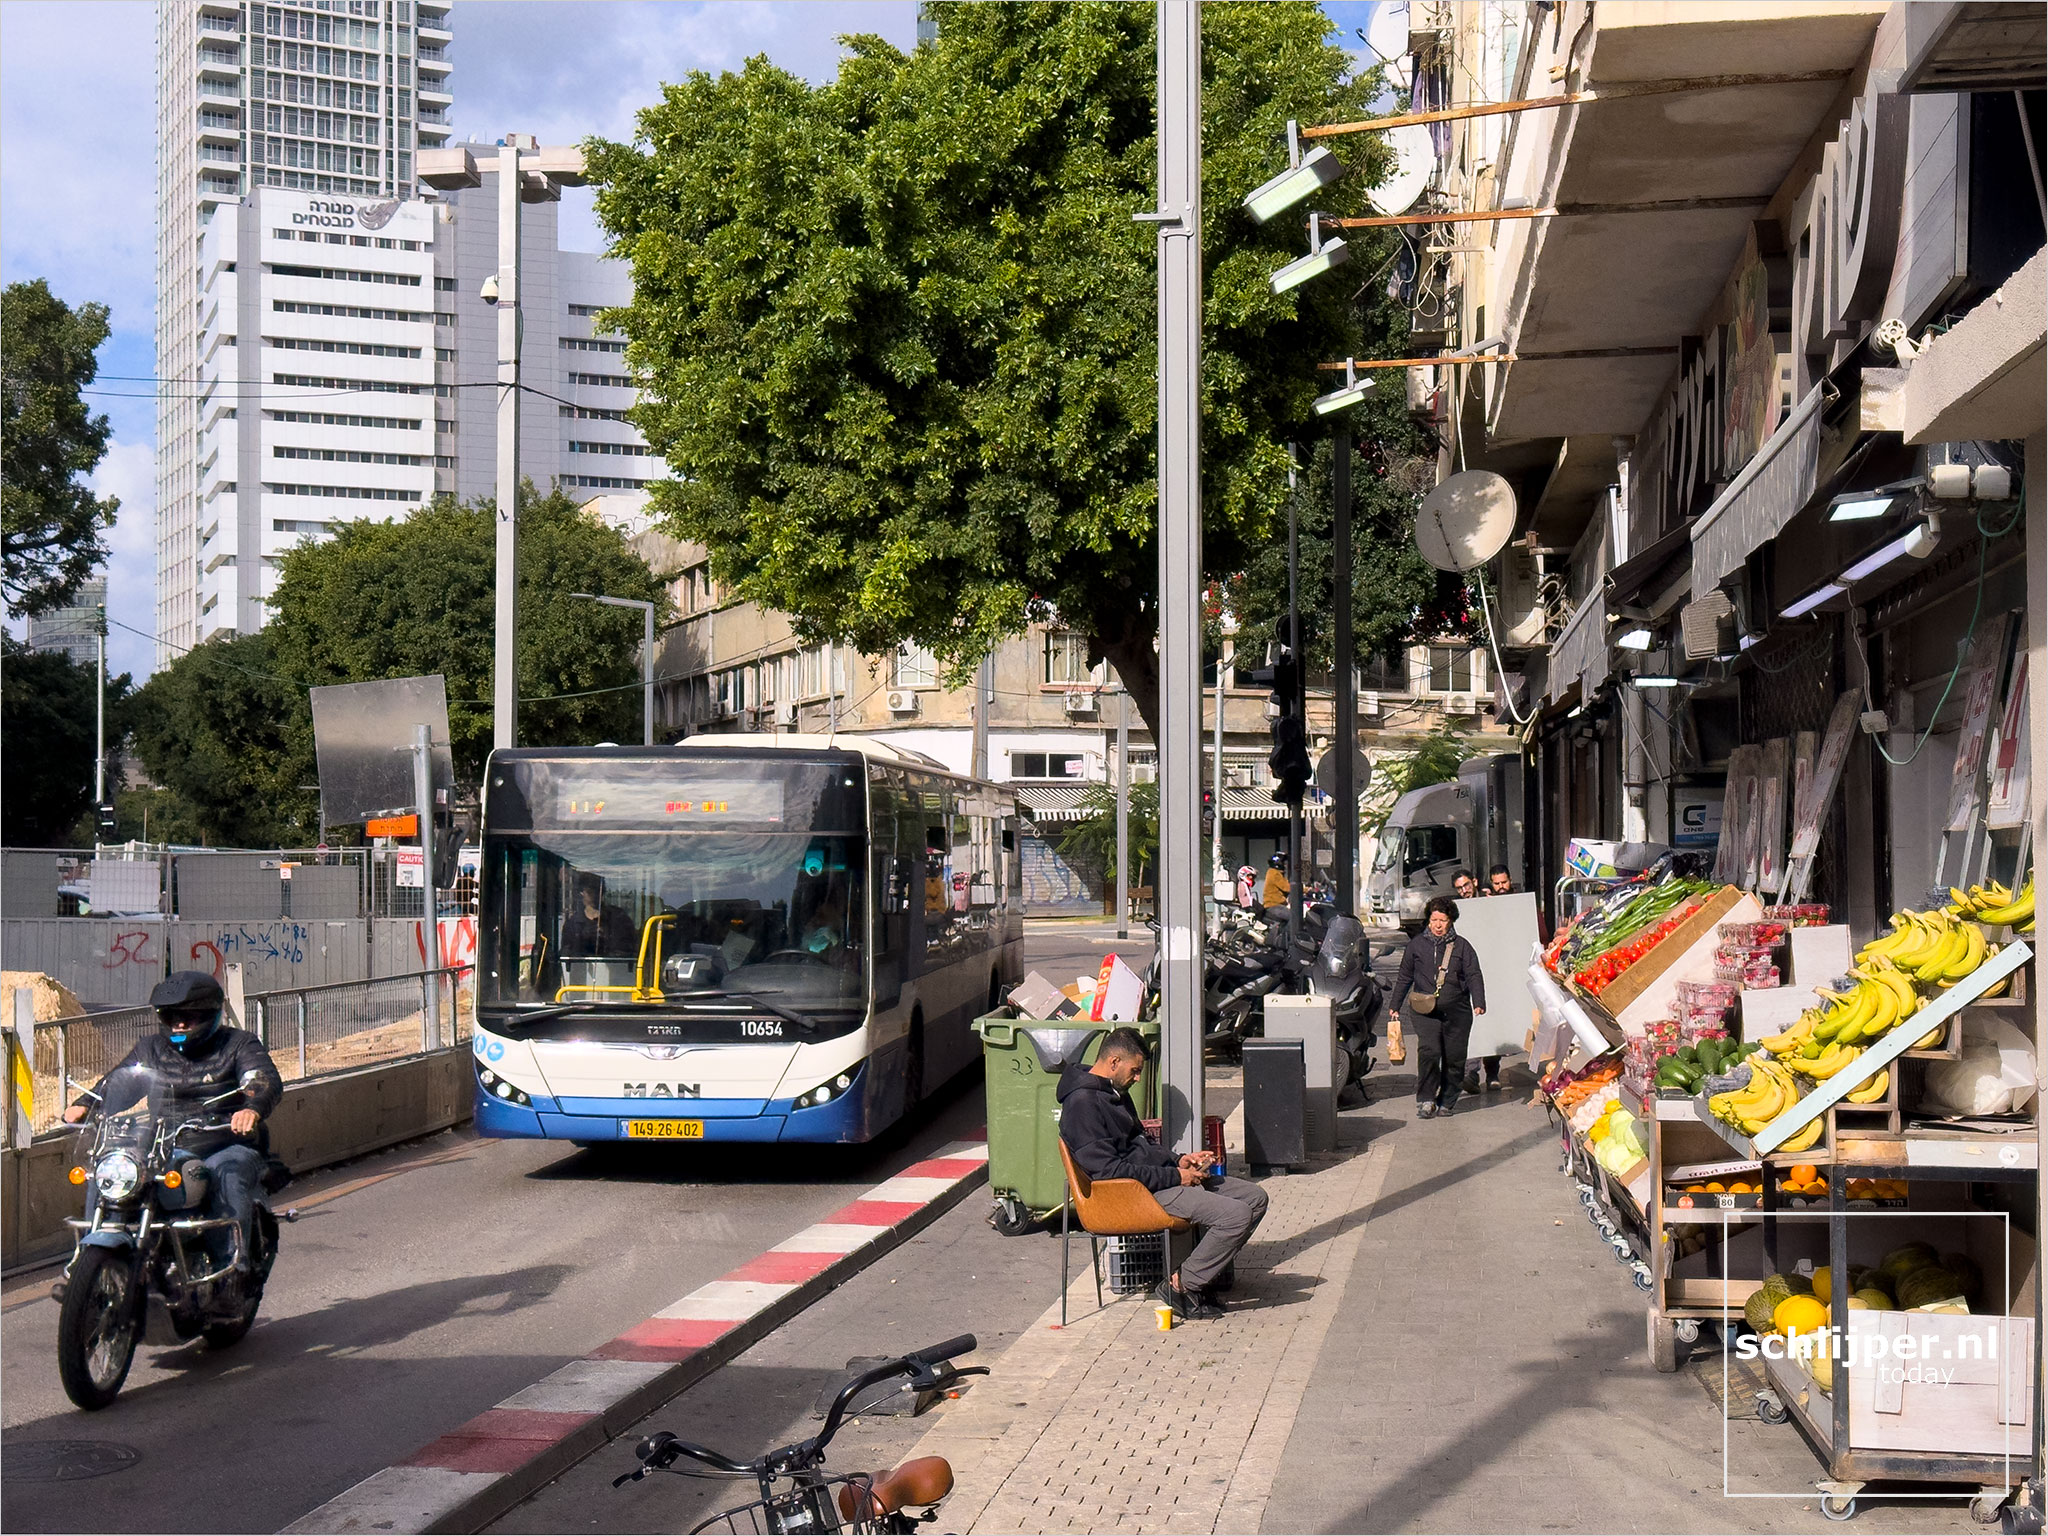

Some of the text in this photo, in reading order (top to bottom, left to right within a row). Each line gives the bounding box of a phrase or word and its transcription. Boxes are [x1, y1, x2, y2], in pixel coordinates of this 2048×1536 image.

[309, 200, 354, 215] מנורה
[292, 212, 354, 229] מבטחים
[1656, 325, 1721, 540] העליה
[647, 1025, 682, 1036] הארגז
[741, 1021, 783, 1037] 10654
[623, 1082, 701, 1099] MAN
[1721, 1199, 1733, 1207] 80
